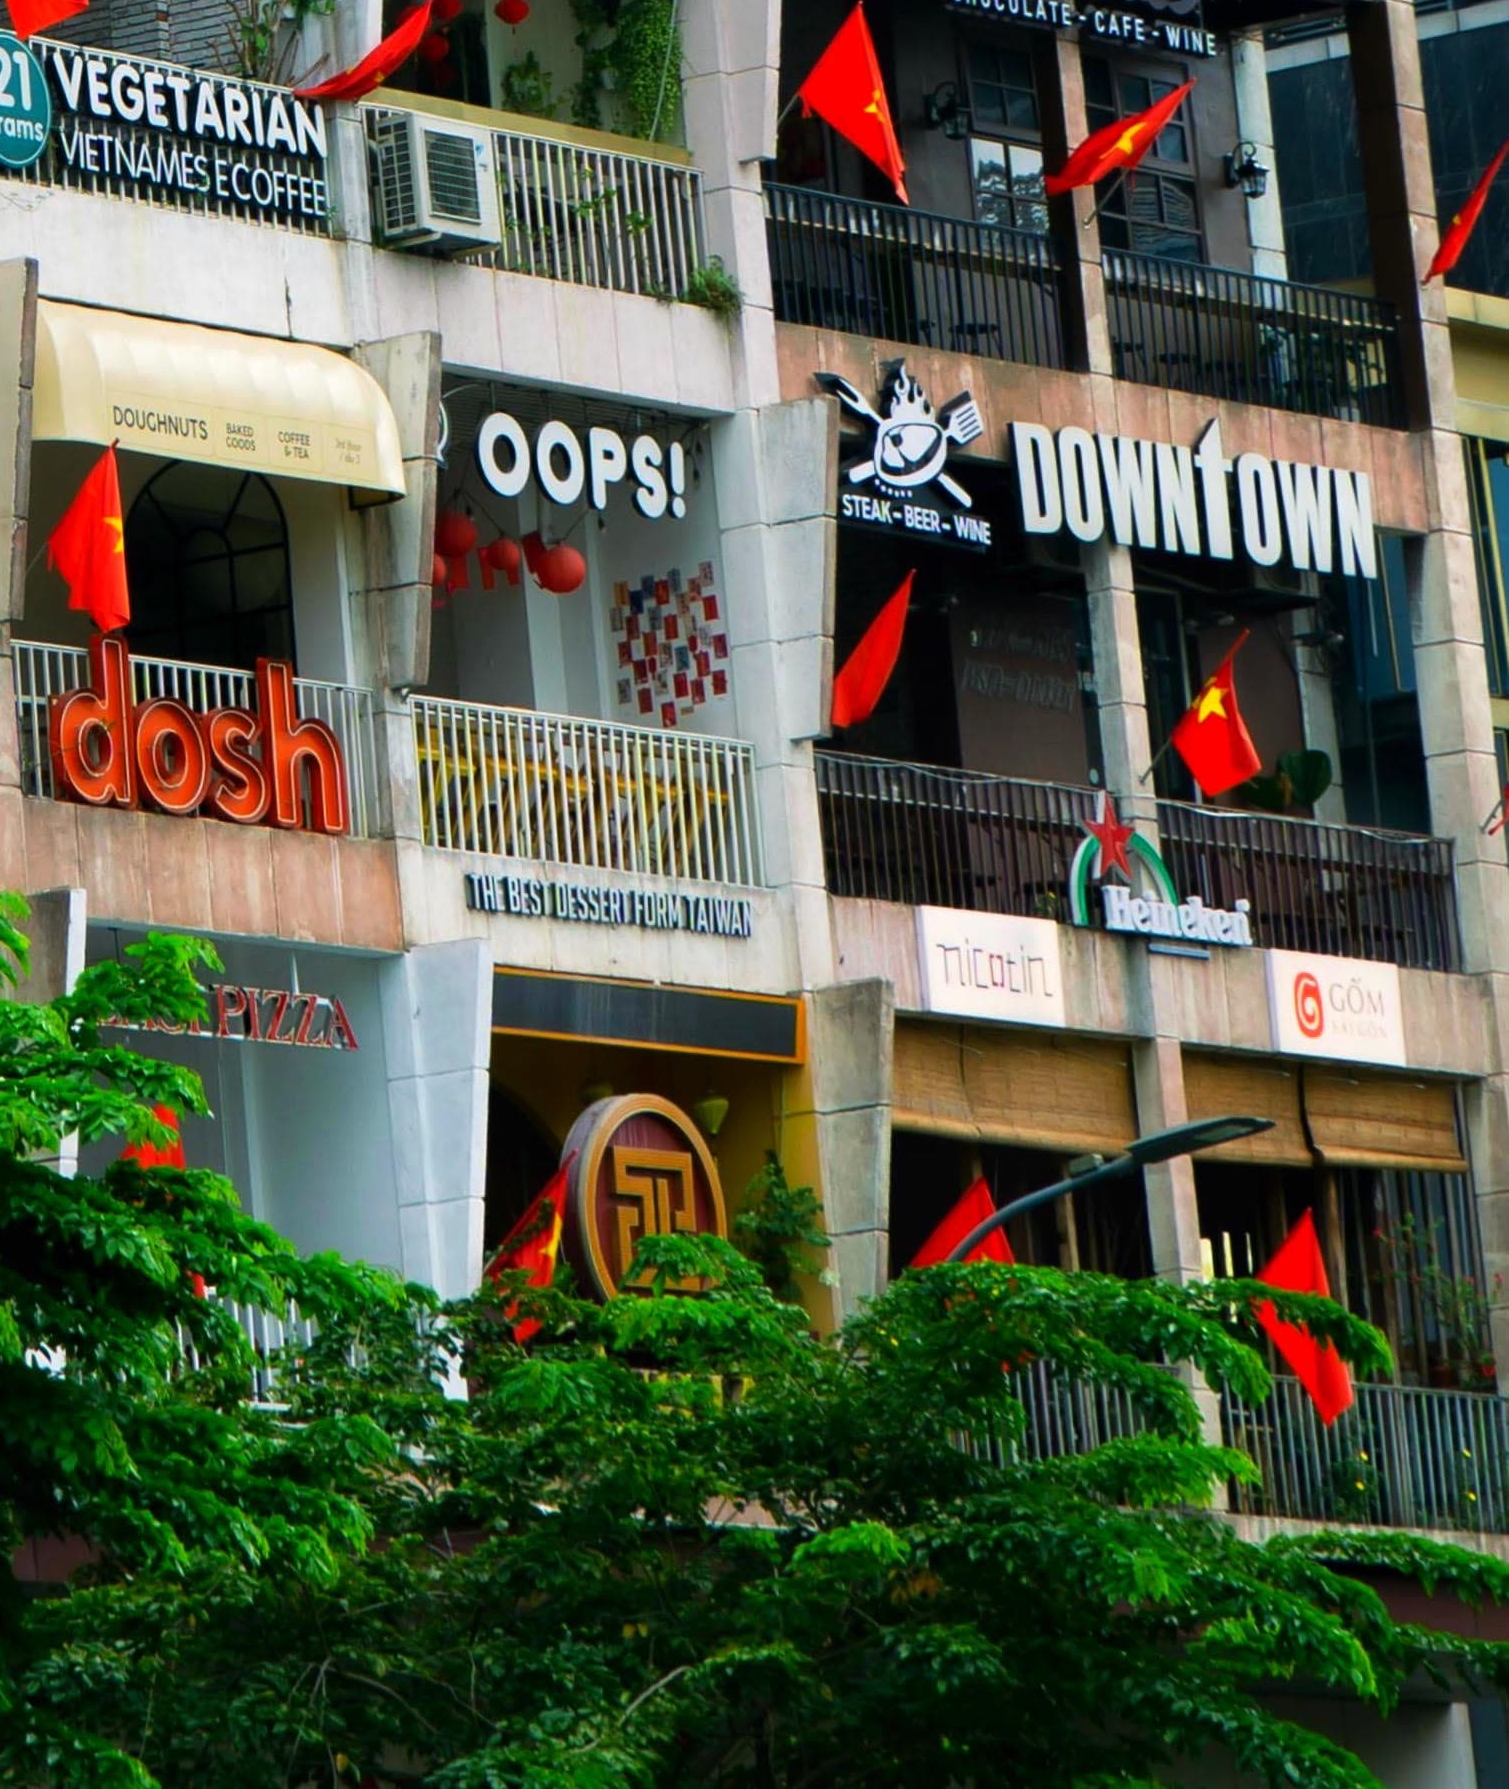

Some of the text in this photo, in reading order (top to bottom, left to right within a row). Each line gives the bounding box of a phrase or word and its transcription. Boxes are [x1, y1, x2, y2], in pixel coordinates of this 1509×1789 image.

[1093, 9, 1147, 42] CAFE
[1164, 24, 1218, 57] WINE
[52, 50, 328, 160] VEGETARIAN
[112, 404, 209, 442] DOUGHNUTS
[225, 422, 254, 438] BAKED
[278, 430, 311, 448] COFFEE
[293, 446, 310, 460] TEA
[477, 412, 687, 520] OOPS!
[842, 493, 894, 525] STEAK
[903, 504, 942, 534] BEER
[953, 514, 993, 546] WINE
[48, 634, 349, 836] dosh
[469, 873, 753, 937] THE BEST DESSERT FORM TAIWAN
[1101, 884, 1253, 948] Heineken
[211, 983, 360, 1052] PIZZA
